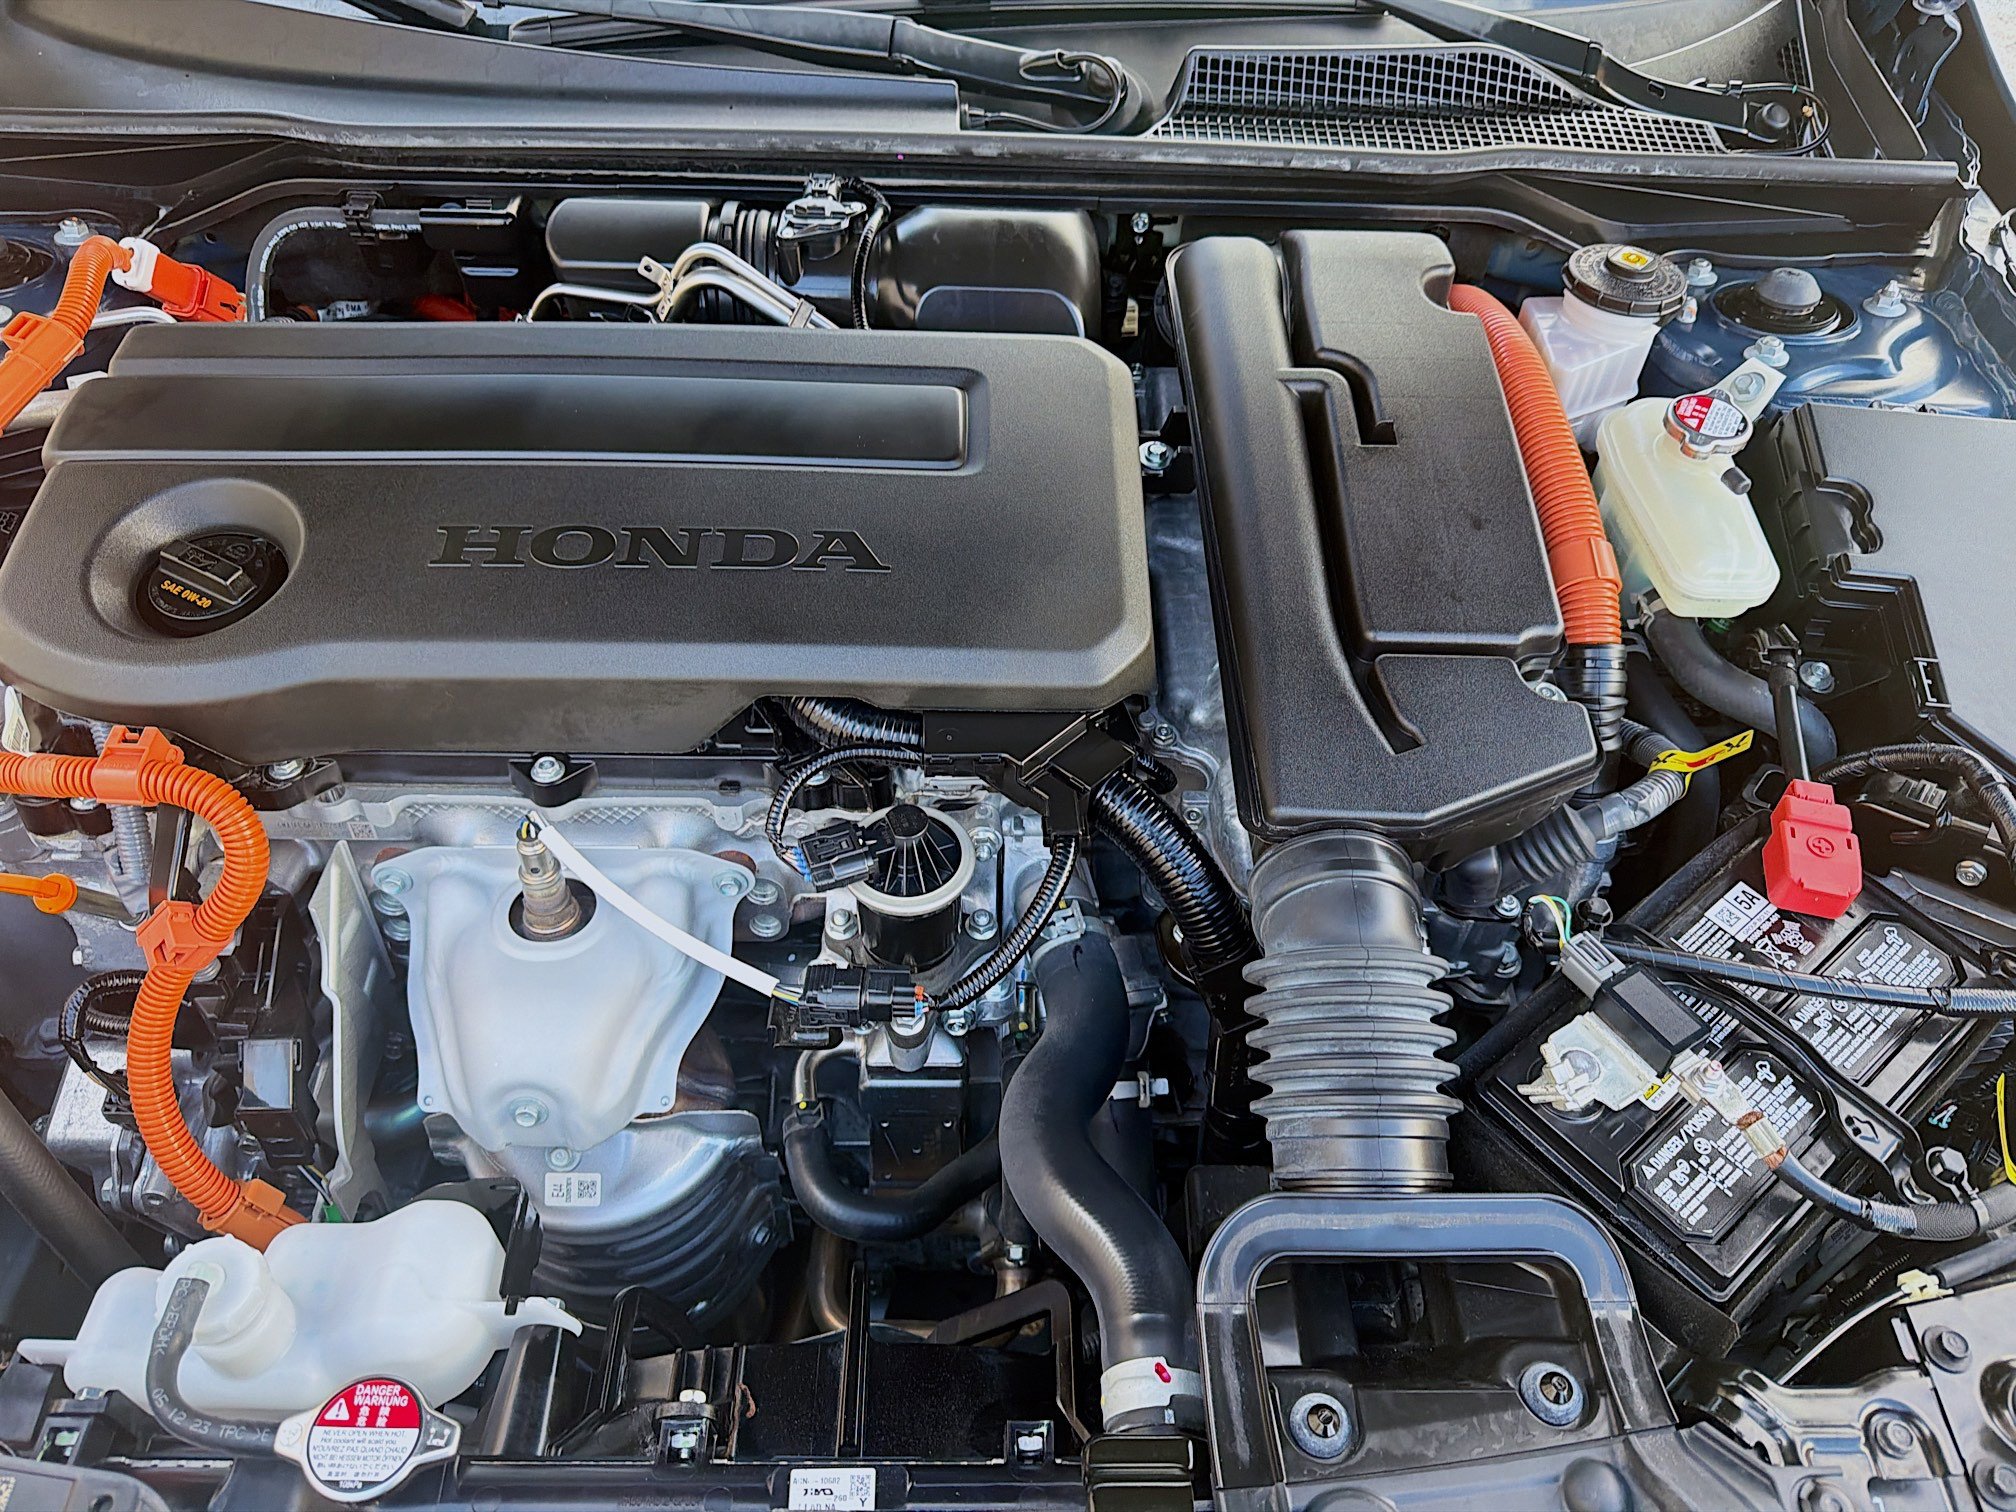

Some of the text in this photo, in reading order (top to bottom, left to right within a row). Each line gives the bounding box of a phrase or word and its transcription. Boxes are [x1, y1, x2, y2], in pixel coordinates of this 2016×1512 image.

[428, 525, 891, 572] HONDA
[160, 580, 184, 596] SAE
[181, 588, 212, 609] 0W-20
[1733, 889, 1761, 910] 5A
[1649, 1105, 1718, 1171] DANGER/POISON
[354, 1395, 408, 1407] WARNUNG
[356, 1384, 401, 1396] DANGER
[167, 1407, 187, 1426] 12
[189, 1419, 212, 1435] 23
[218, 1424, 246, 1440] TPC
[859, 1497, 868, 1507] Y
